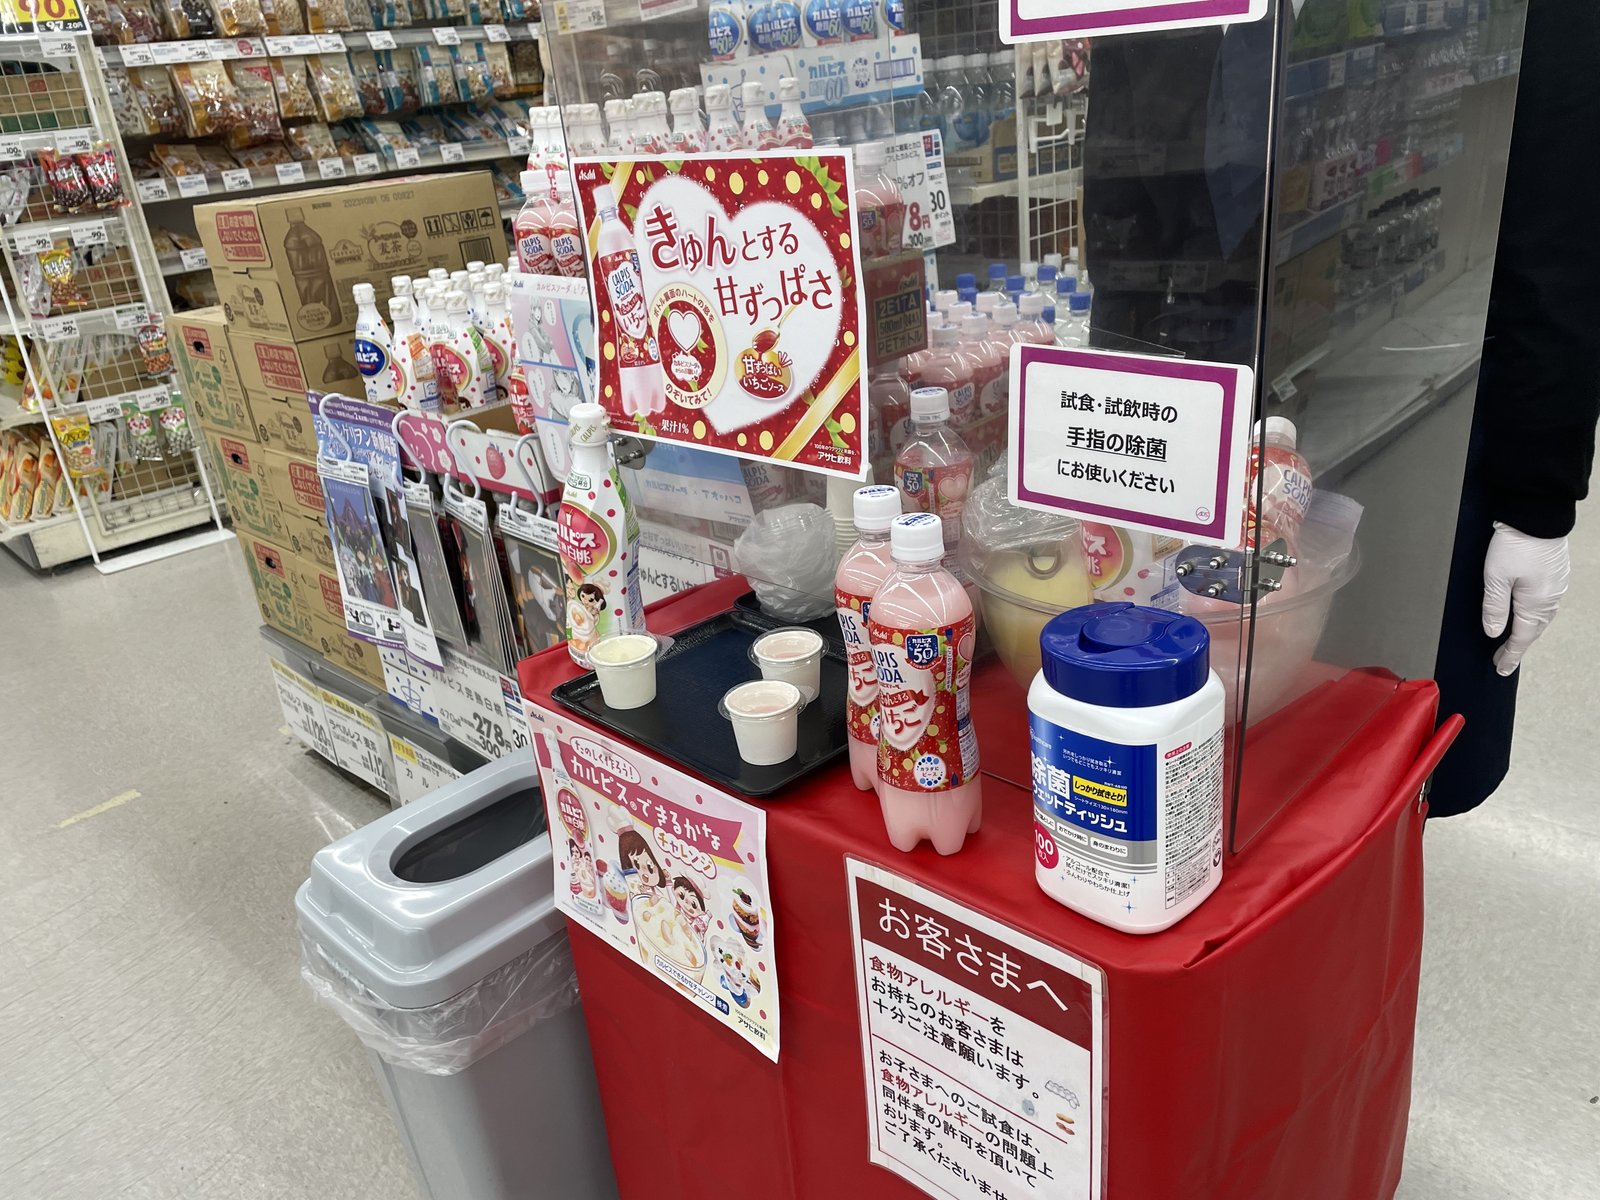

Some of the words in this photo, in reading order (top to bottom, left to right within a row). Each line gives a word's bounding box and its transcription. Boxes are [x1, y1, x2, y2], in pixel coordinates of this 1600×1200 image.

[579, 169, 596, 180] Asahi
[645, 203, 800, 273] きゅんとする
[611, 266, 631, 286] CALPIS
[615, 279, 636, 299] SODA
[713, 263, 834, 326] 甘ずっぱさ
[355, 351, 379, 363] ルピス
[743, 356, 782, 376] 甘ずっぱい
[743, 377, 785, 393] いちごソース
[1060, 390, 1178, 424] 試食・試飲時の
[581, 424, 597, 443] CALPIS
[661, 419, 689, 435] 果汁1%
[1066, 425, 1168, 461] 手指の除菌
[818, 451, 852, 465] アサヒ飲料
[1057, 458, 1176, 494] にお使いください
[840, 614, 857, 630] PIS
[872, 630, 888, 641] Asahi
[913, 647, 934, 663] 50
[850, 665, 878, 691] ちご
[877, 667, 904, 684] ODA
[883, 703, 922, 735] いちご
[574, 739, 634, 780] たのしく作ろう!
[1074, 780, 1127, 803] しっかり拭きとり!
[1032, 781, 1128, 833] ウェットティッシュ
[657, 832, 712, 871] チャレンジ
[1034, 829, 1054, 856] 100
[1093, 840, 1127, 855] 身のまわりに
[878, 897, 1069, 1012] お客さまへ
[716, 999, 728, 1013] 検索
[869, 955, 1006, 1037] 食物アレルギーを
[737, 1016, 766, 1041] アサヒ飲料
[871, 975, 1024, 1068] お持ちのお客さまは
[872, 998, 1040, 1100] 十分ご注意願います。
[879, 1049, 1041, 1154] お子さまへのご試食は、
[880, 1068, 1055, 1180] 食物アレルギーの問題上
[882, 1084, 1038, 1189] 同伴者の許可を頂いて
[883, 1102, 945, 1149] おります。
